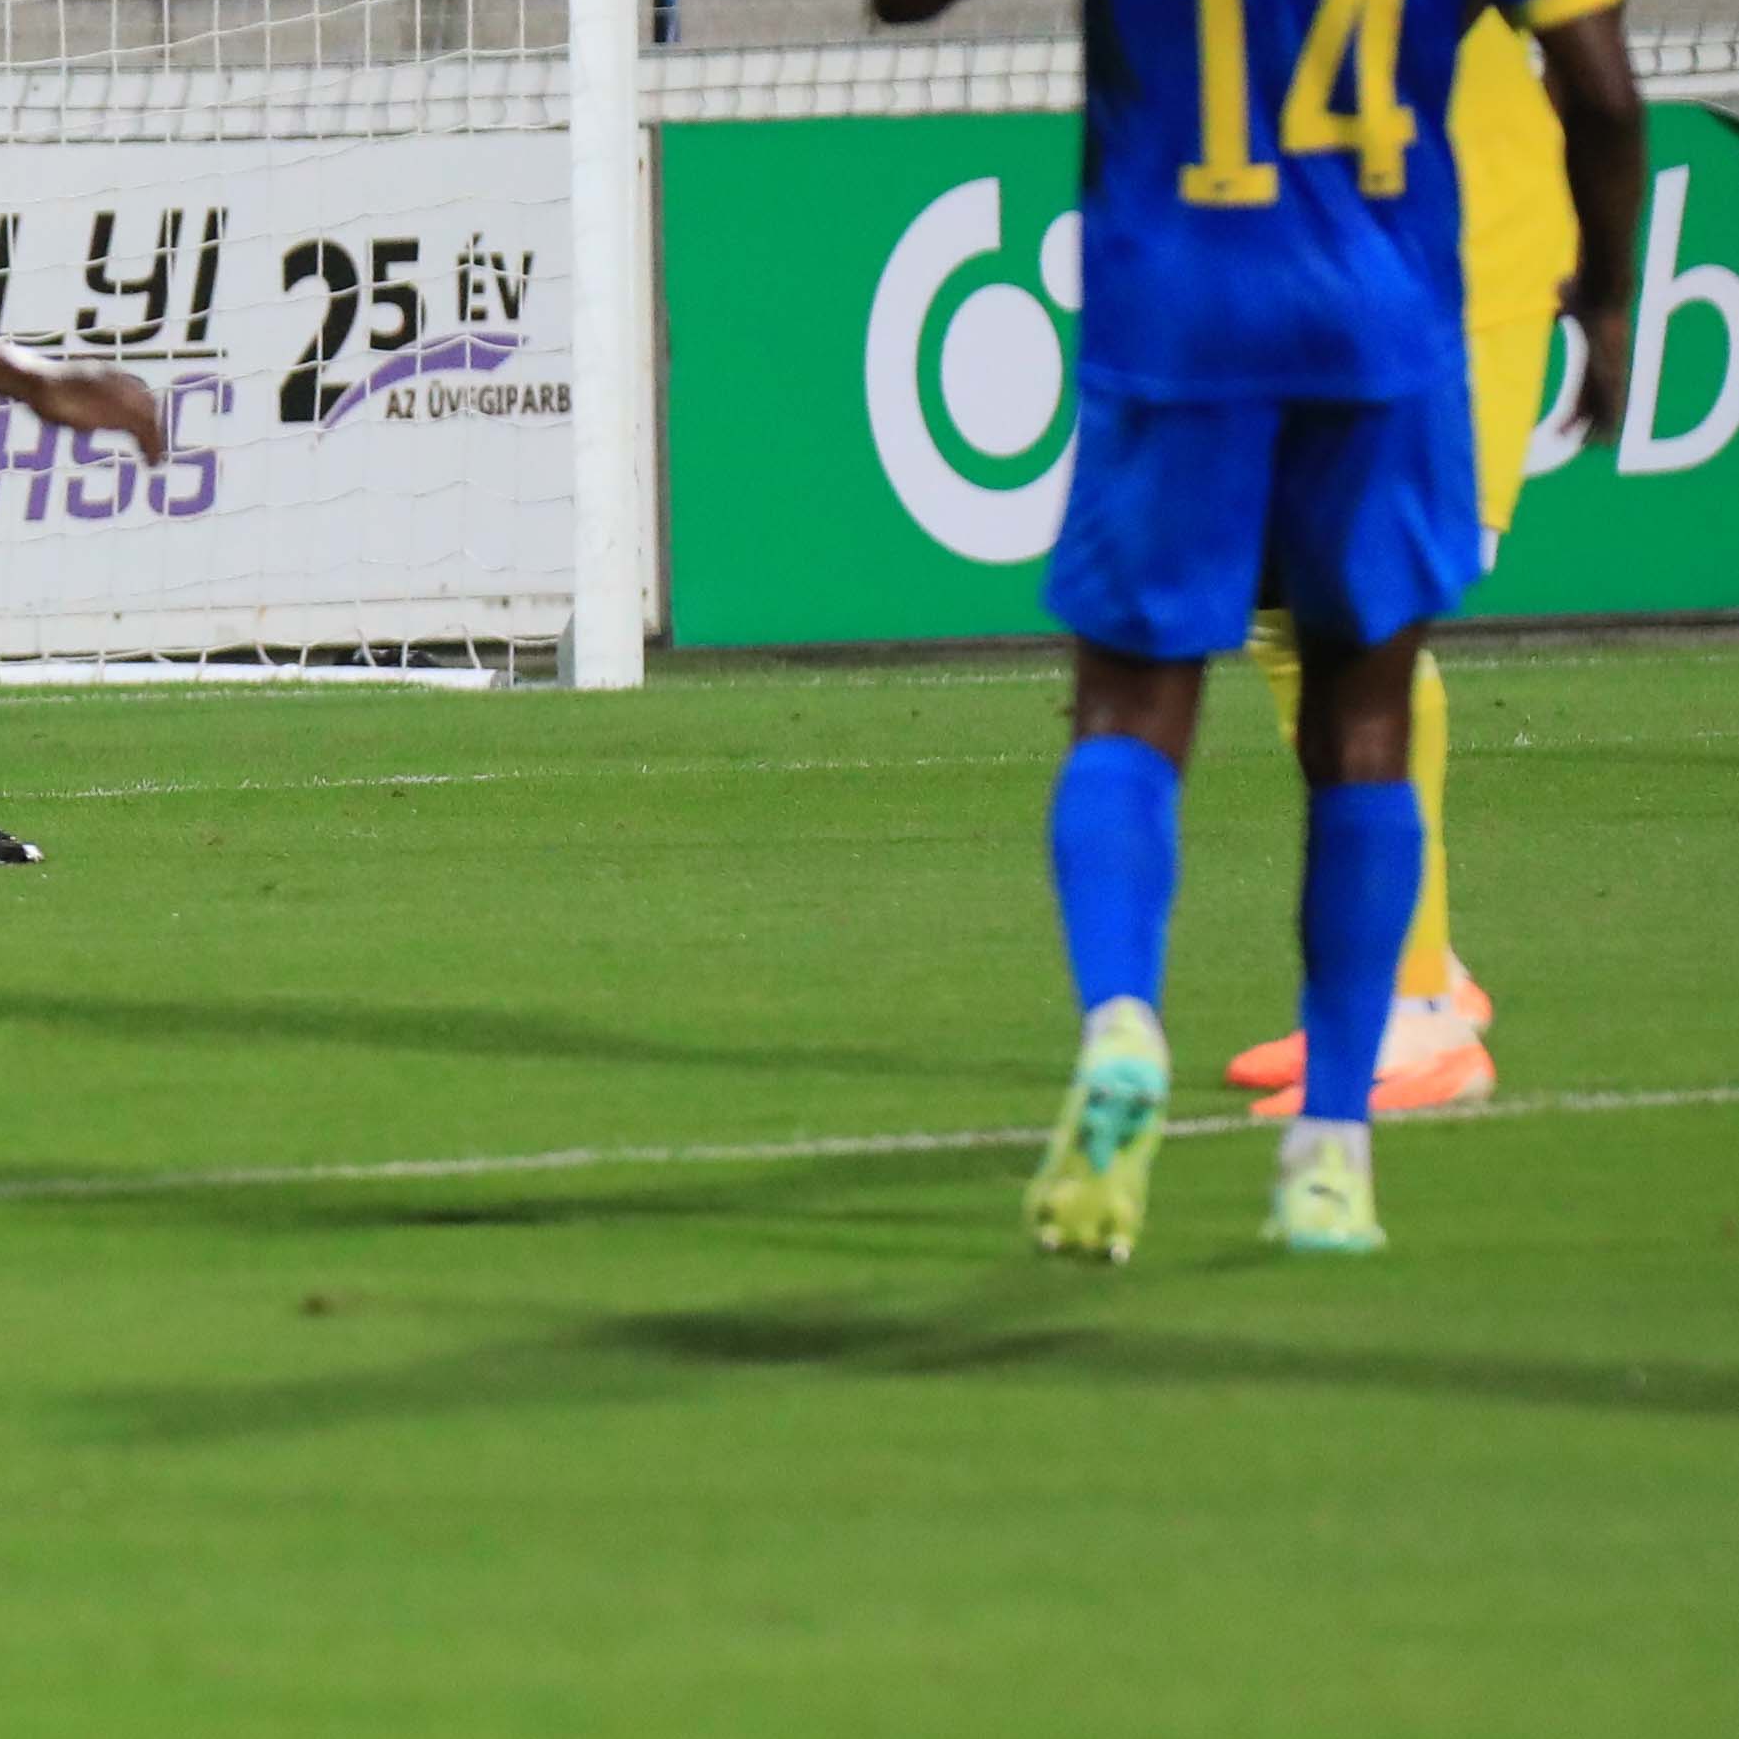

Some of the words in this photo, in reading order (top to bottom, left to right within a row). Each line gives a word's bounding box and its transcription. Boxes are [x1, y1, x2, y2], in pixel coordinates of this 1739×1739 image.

[278, 236, 426, 424] 25
[456, 232, 535, 321] ÉV
[385, 388, 417, 419] AZ
